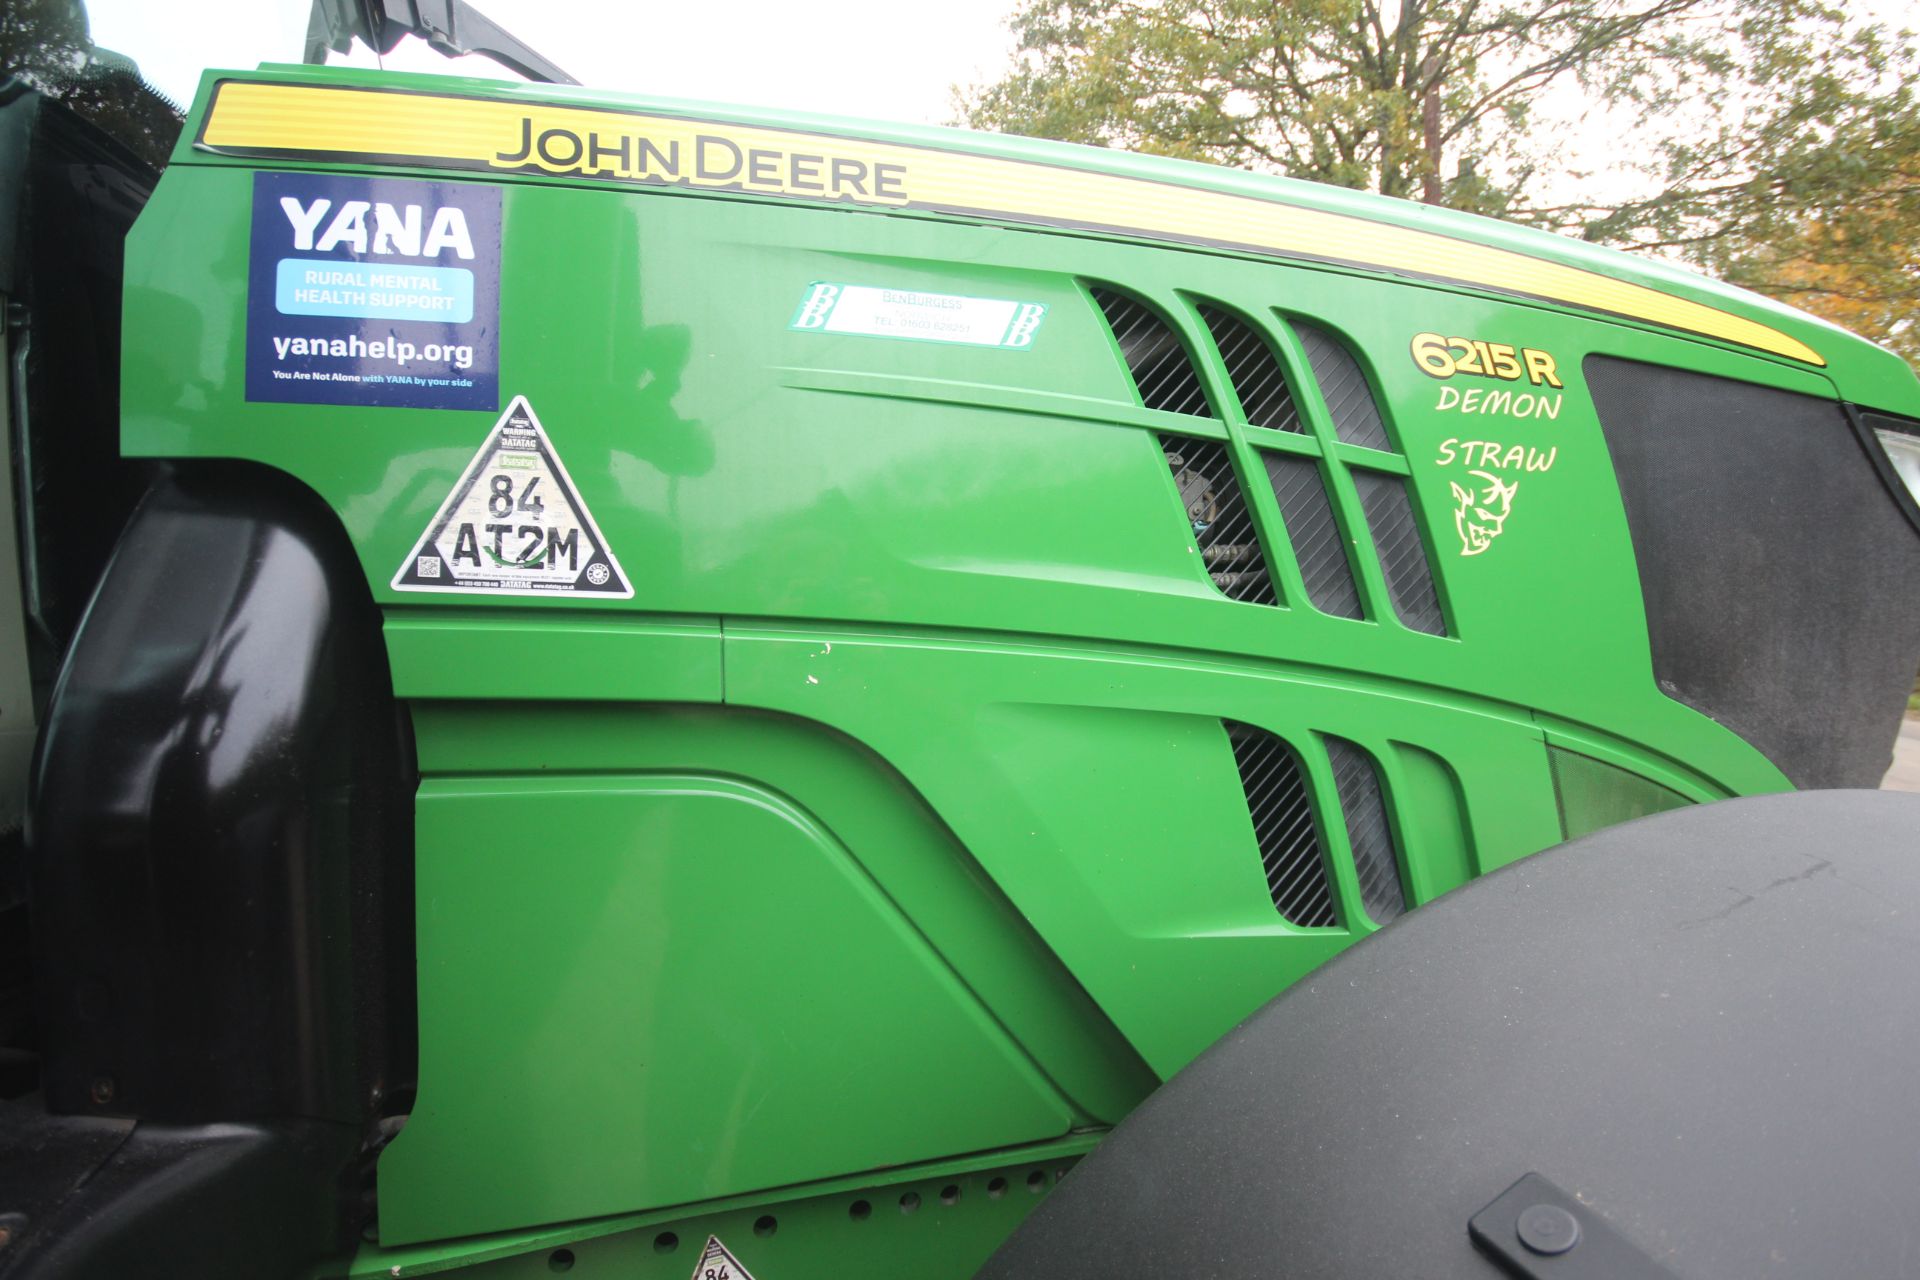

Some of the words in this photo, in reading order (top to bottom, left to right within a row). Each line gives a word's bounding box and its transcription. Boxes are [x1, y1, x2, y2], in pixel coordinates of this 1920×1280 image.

[280, 197, 475, 259] YANA
[305, 270, 367, 287] RURAL
[370, 275, 442, 291] MENTAL
[295, 289, 366, 305] HEALTH
[369, 292, 455, 311] SUPPORT
[273, 335, 473, 368] yanahelp.org
[272, 370, 292, 379] You
[293, 371, 311, 380] Are
[312, 372, 330, 381] Not
[331, 373, 361, 382] Alone
[362, 375, 384, 383] with
[386, 376, 413, 384] YANA
[414, 377, 426, 386] by
[427, 378, 450, 387] your
[451, 378, 473, 387] side
[1435, 386, 1562, 420] DEMON
[503, 427, 536, 437] WARNING
[1435, 438, 1556, 472] STRAW
[488, 474, 545, 520] 84
[451, 522, 579, 571] AT2M
[705, 1265, 729, 1280] 84
